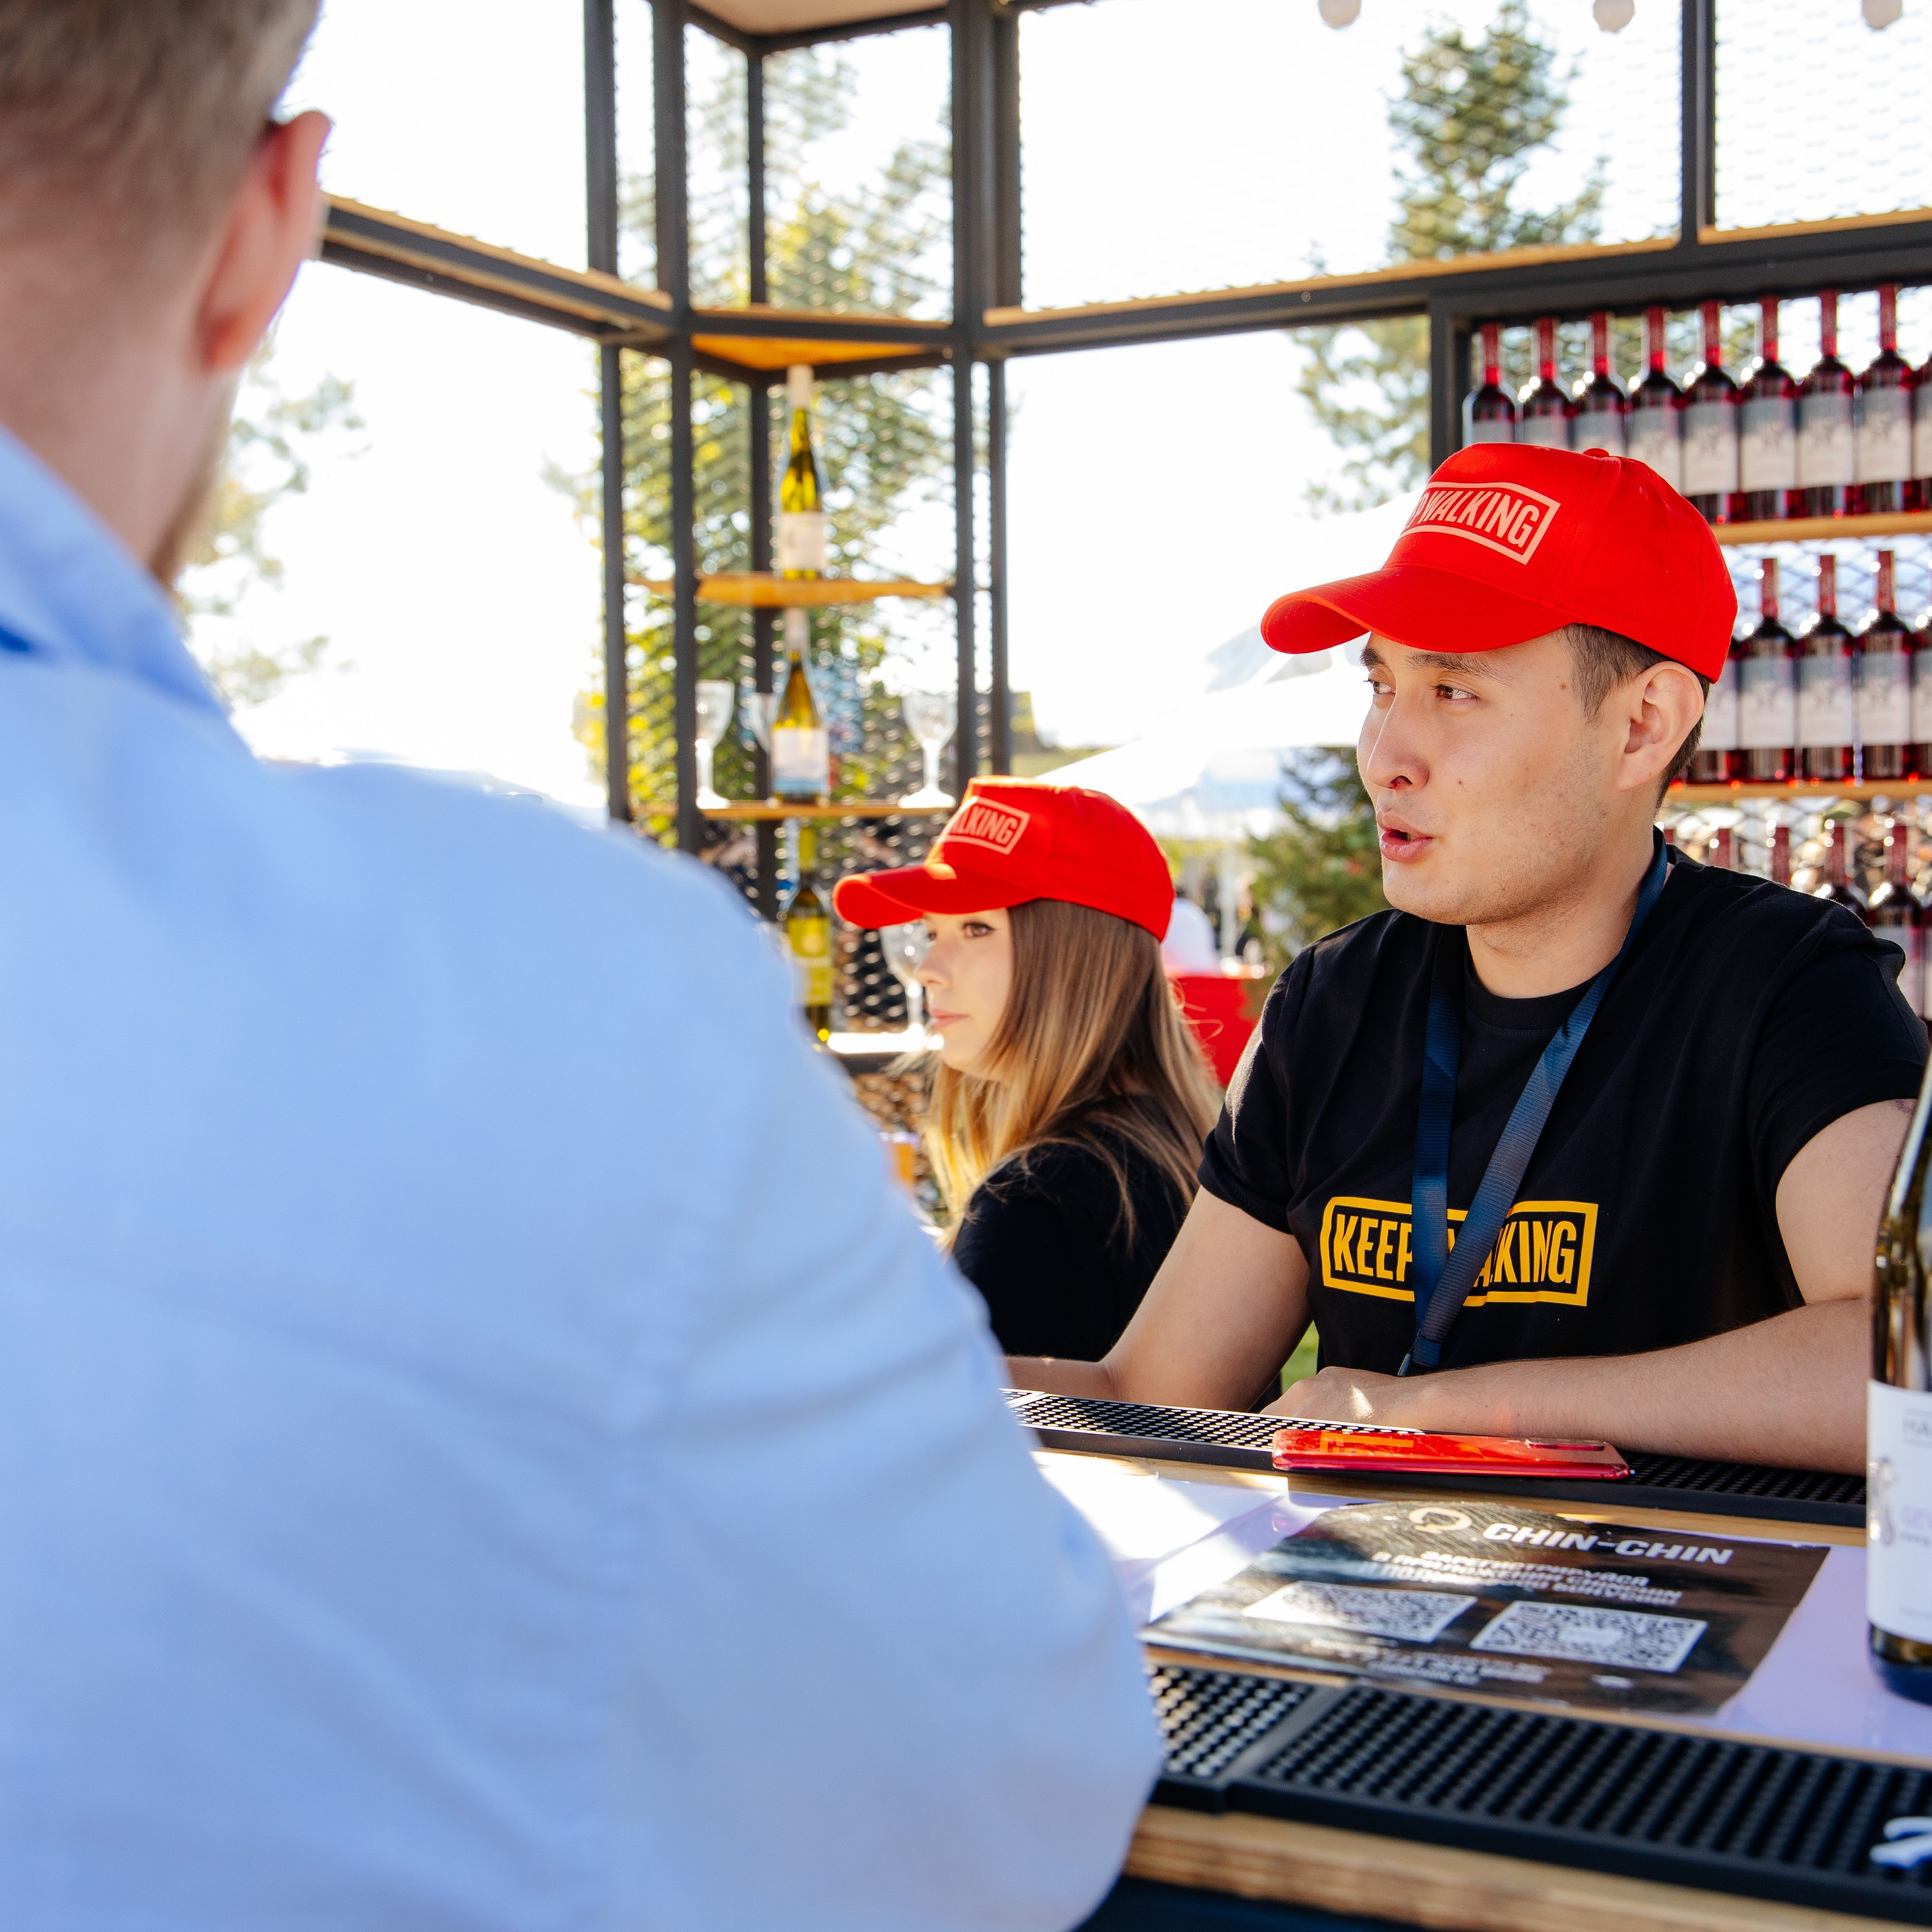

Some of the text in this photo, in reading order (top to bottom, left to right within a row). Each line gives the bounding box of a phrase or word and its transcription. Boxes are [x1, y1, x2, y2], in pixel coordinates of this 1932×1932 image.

[1417, 490, 1540, 549] WALKING
[952, 804, 1018, 844] LKING
[1334, 1214, 1413, 1282] KEEP
[1482, 1523, 1734, 1565] CHIN-CHIN
